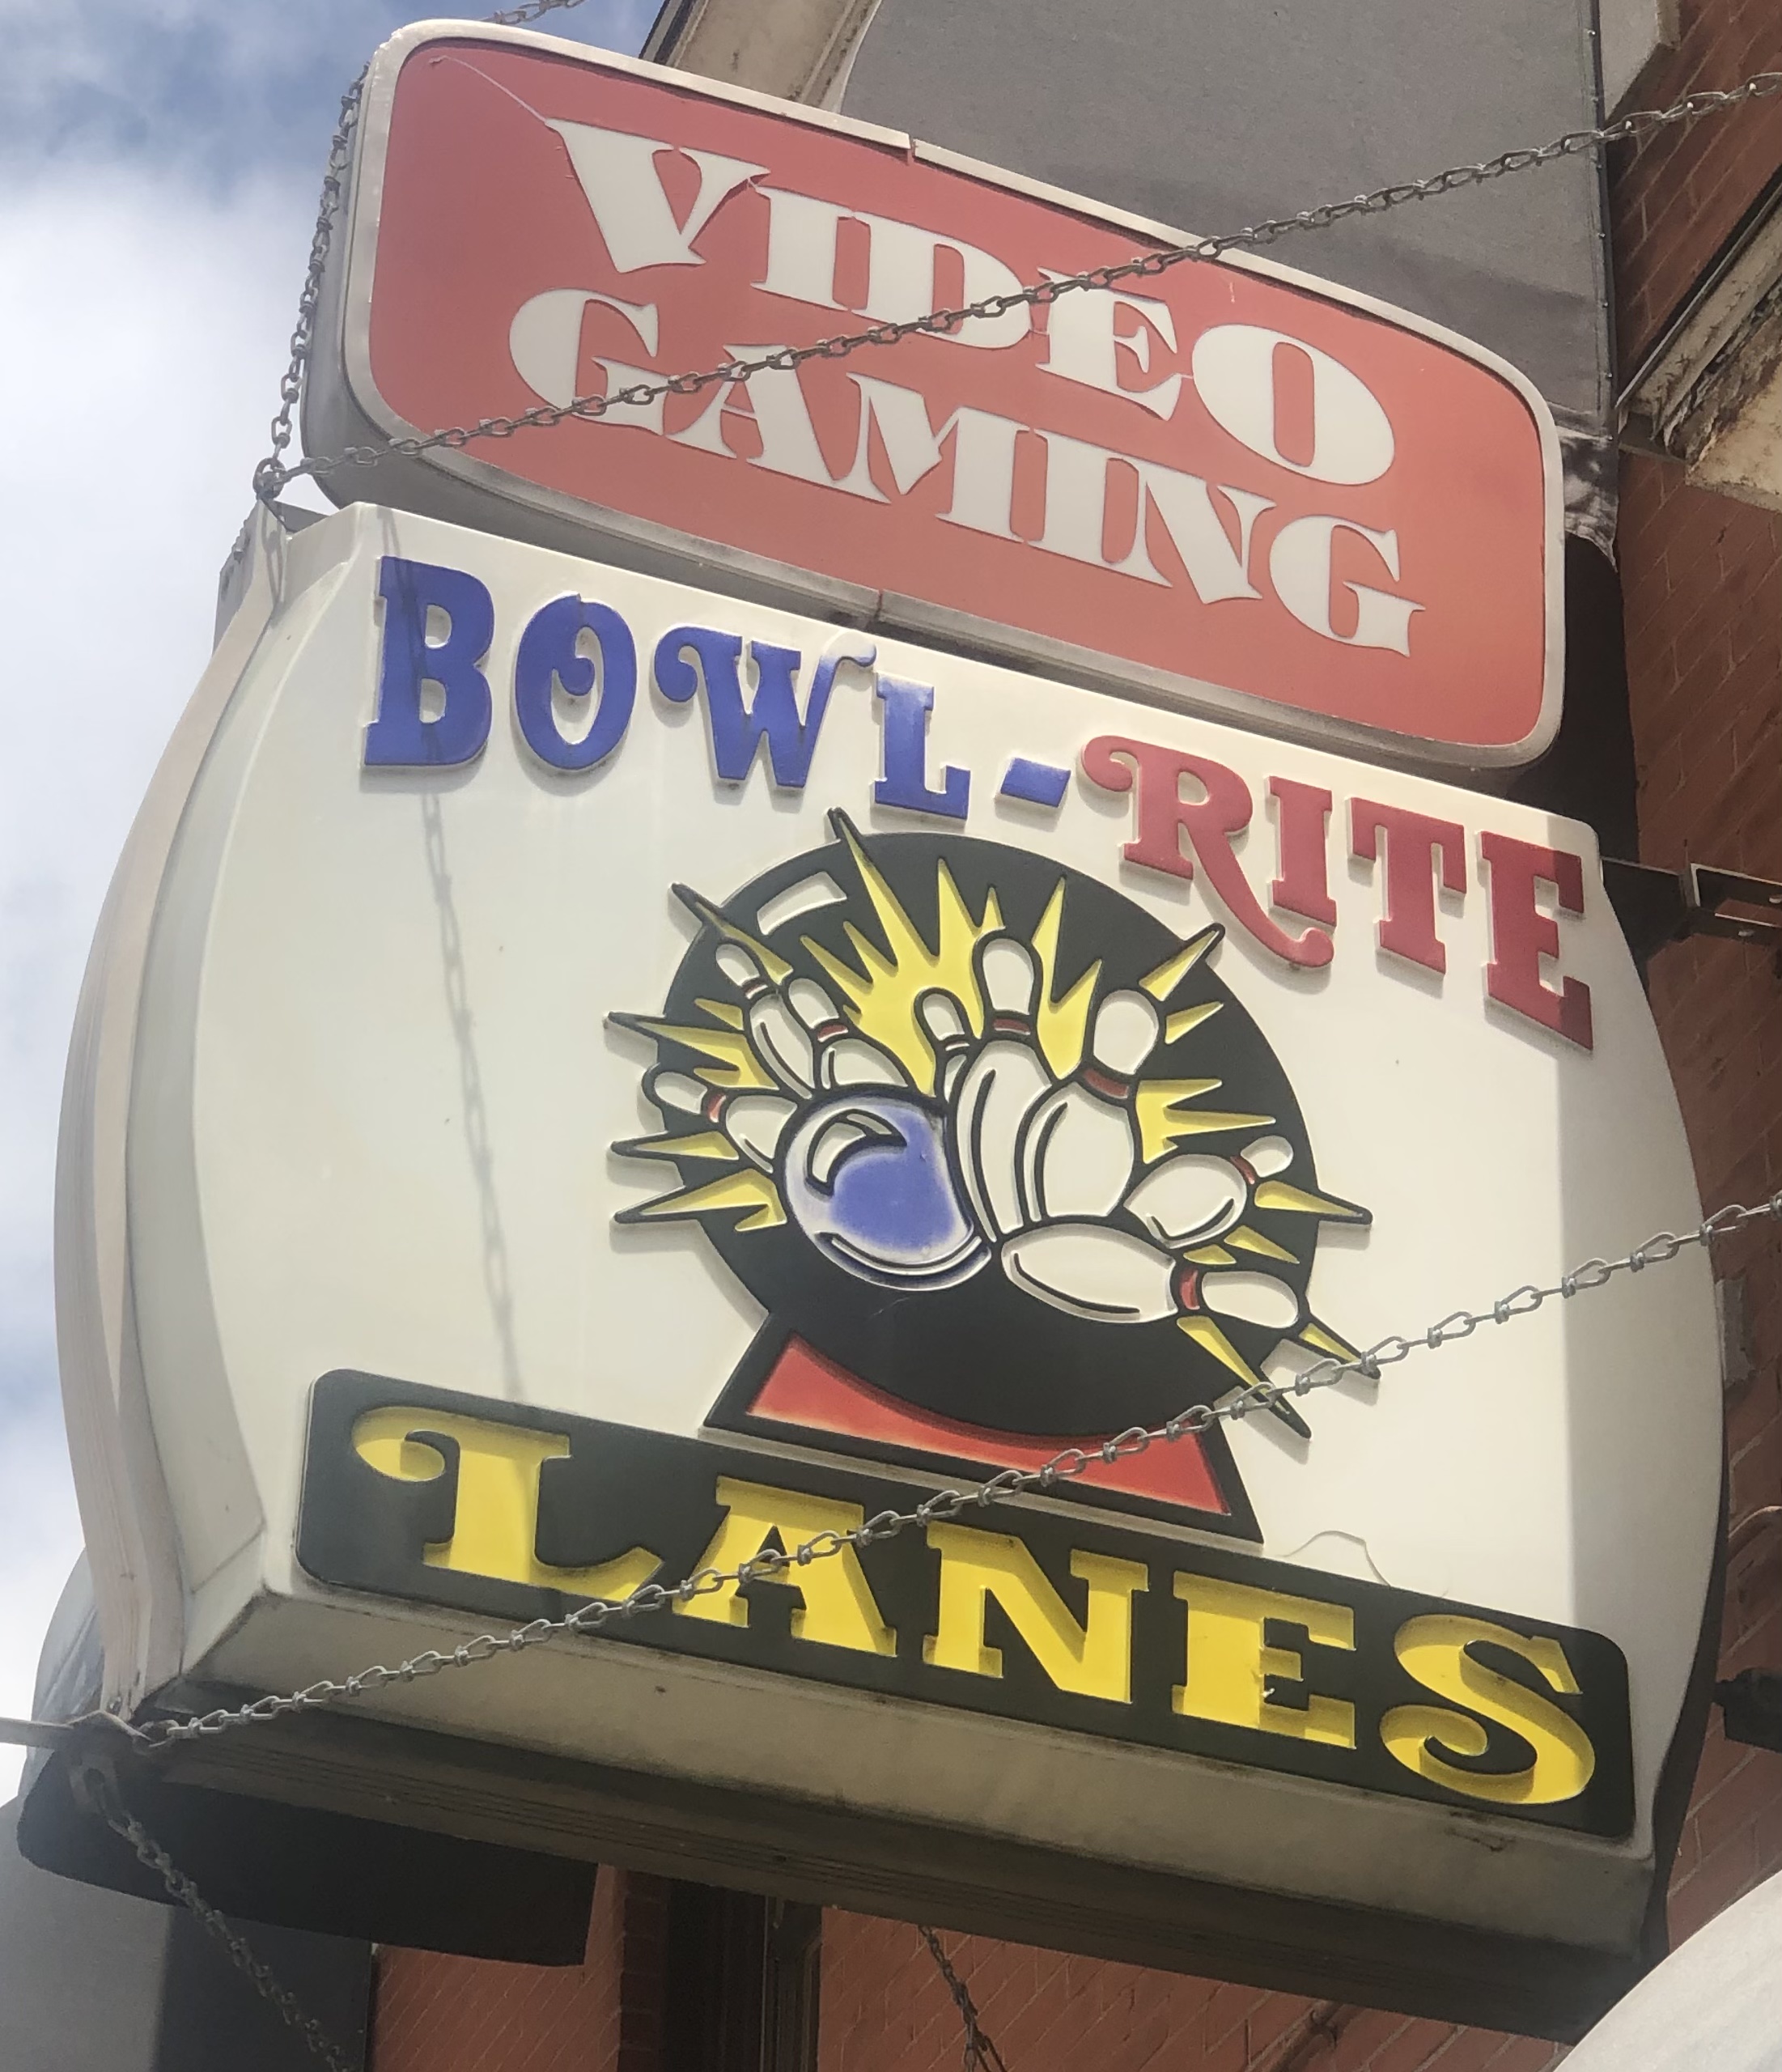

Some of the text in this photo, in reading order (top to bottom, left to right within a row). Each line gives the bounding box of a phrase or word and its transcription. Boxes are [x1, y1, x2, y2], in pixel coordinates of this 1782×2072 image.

[509, 287, 1426, 657] GAMING
[545, 118, 1396, 486] VIDEO
[362, 554, 1593, 1051] BOWL-RITE
[351, 1405, 1596, 1805] LANES
